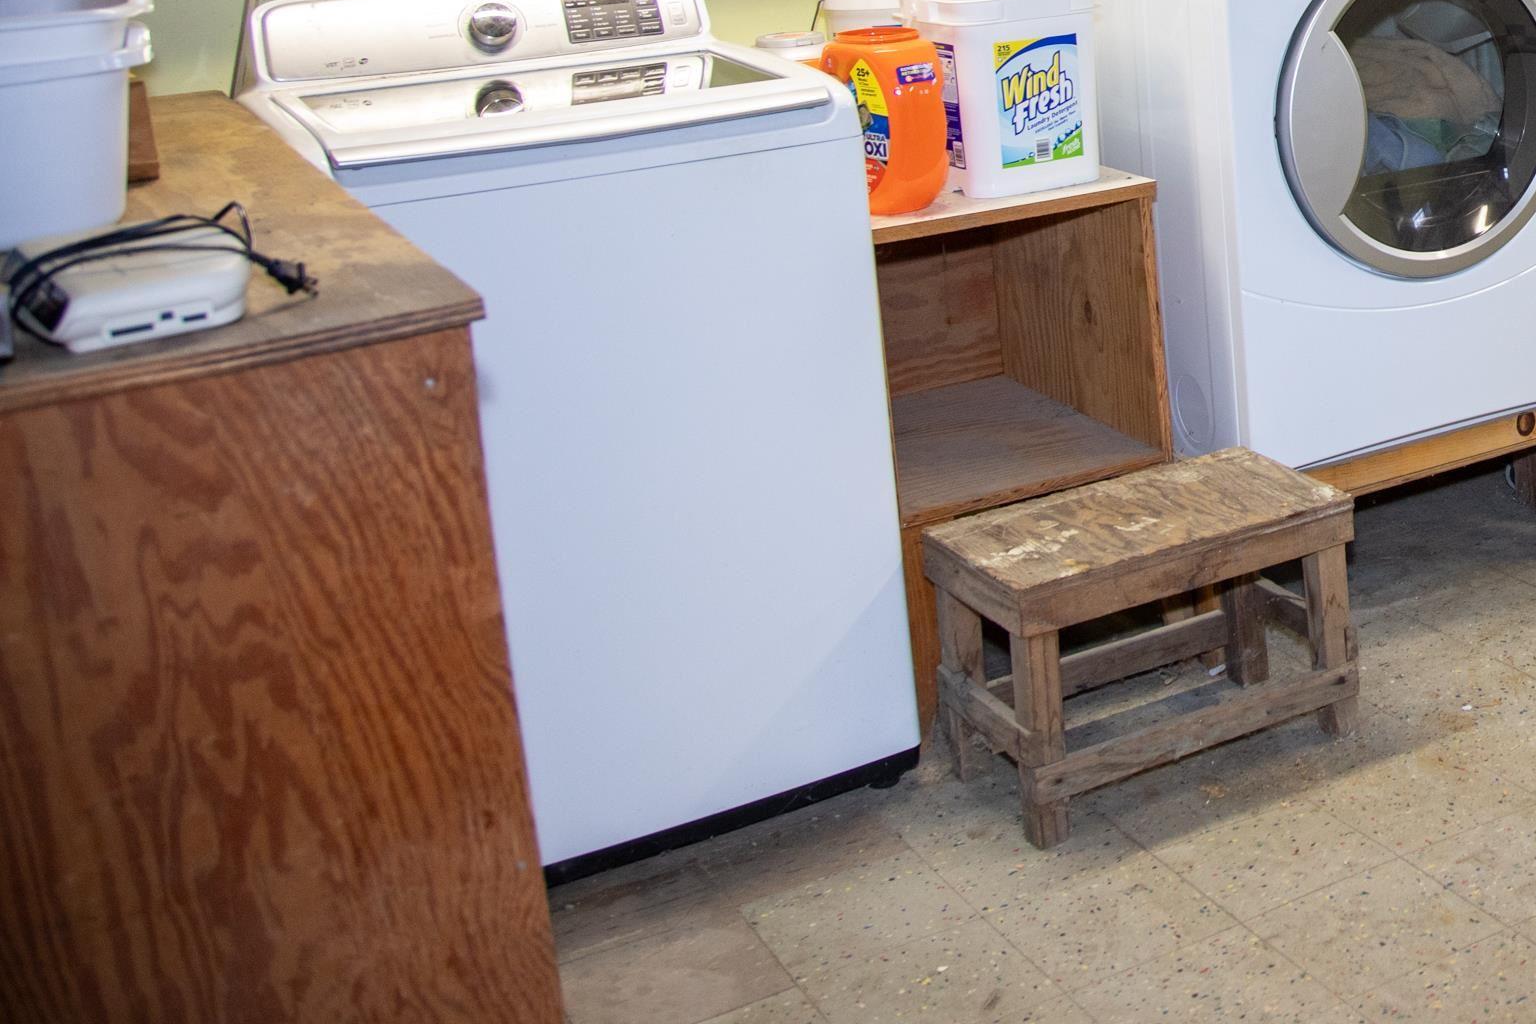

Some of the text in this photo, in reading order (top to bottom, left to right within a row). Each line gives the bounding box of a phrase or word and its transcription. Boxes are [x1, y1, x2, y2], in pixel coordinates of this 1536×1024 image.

[1001, 50, 1060, 111] Wind
[1012, 71, 1074, 136] Fresh
[1027, 117, 1050, 131] Laundry
[865, 133, 886, 142] ULTRA
[864, 141, 887, 158] OXI
